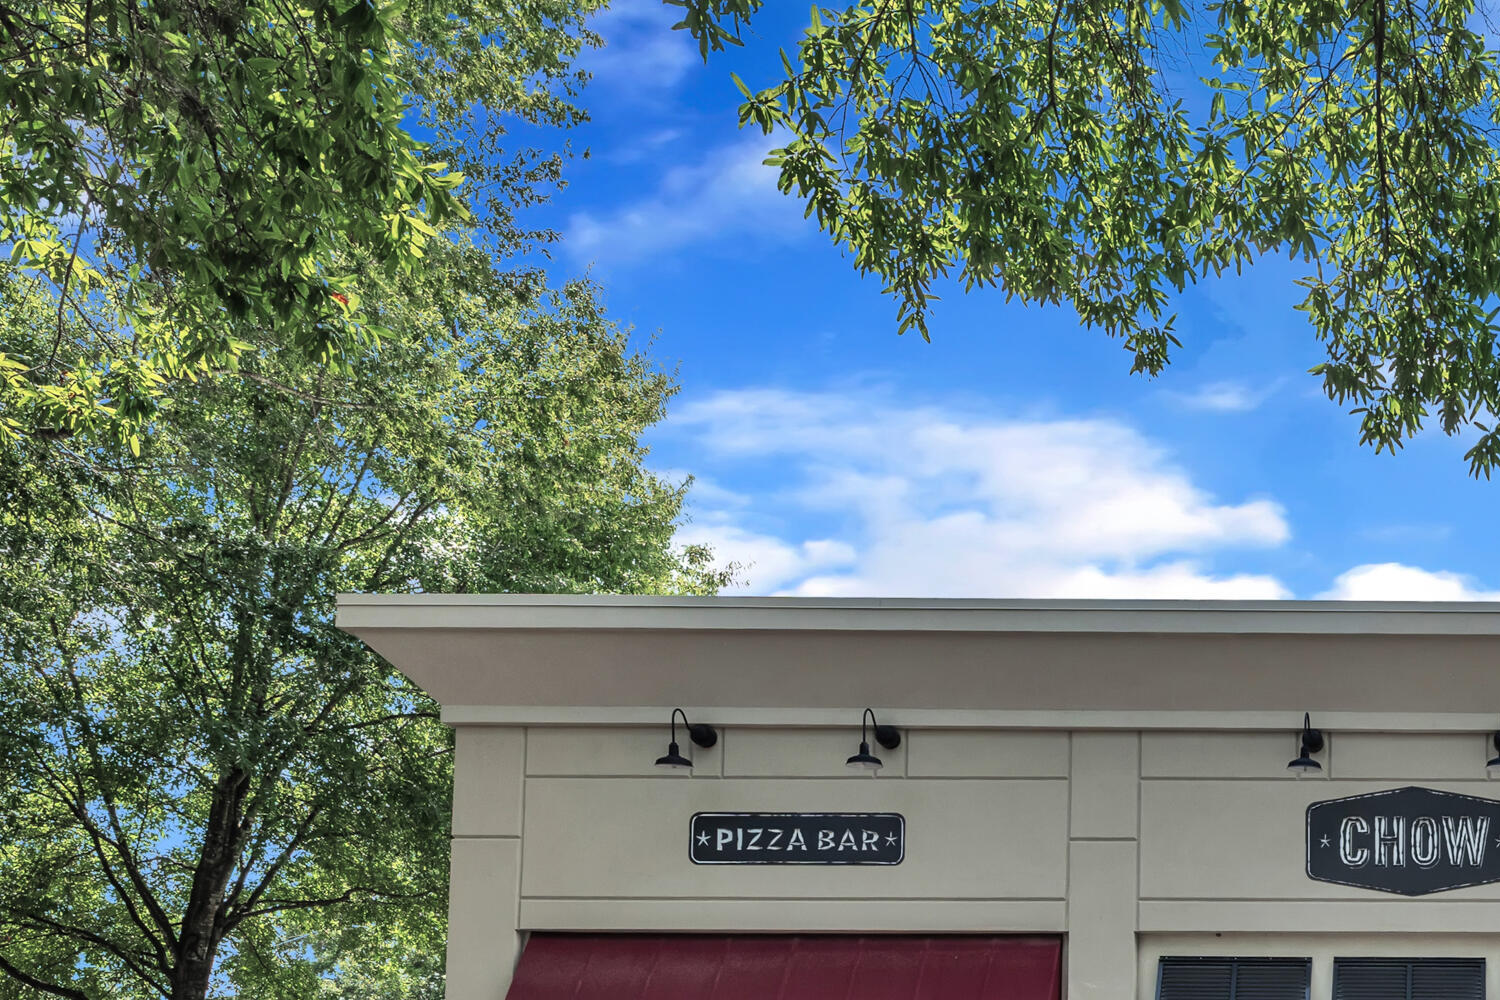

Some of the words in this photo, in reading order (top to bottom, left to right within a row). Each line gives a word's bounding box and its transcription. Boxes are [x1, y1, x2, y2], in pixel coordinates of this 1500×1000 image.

[716, 828, 807, 851] PIZZA
[817, 828, 879, 851] BAR
[1339, 816, 1490, 868] CHOW
